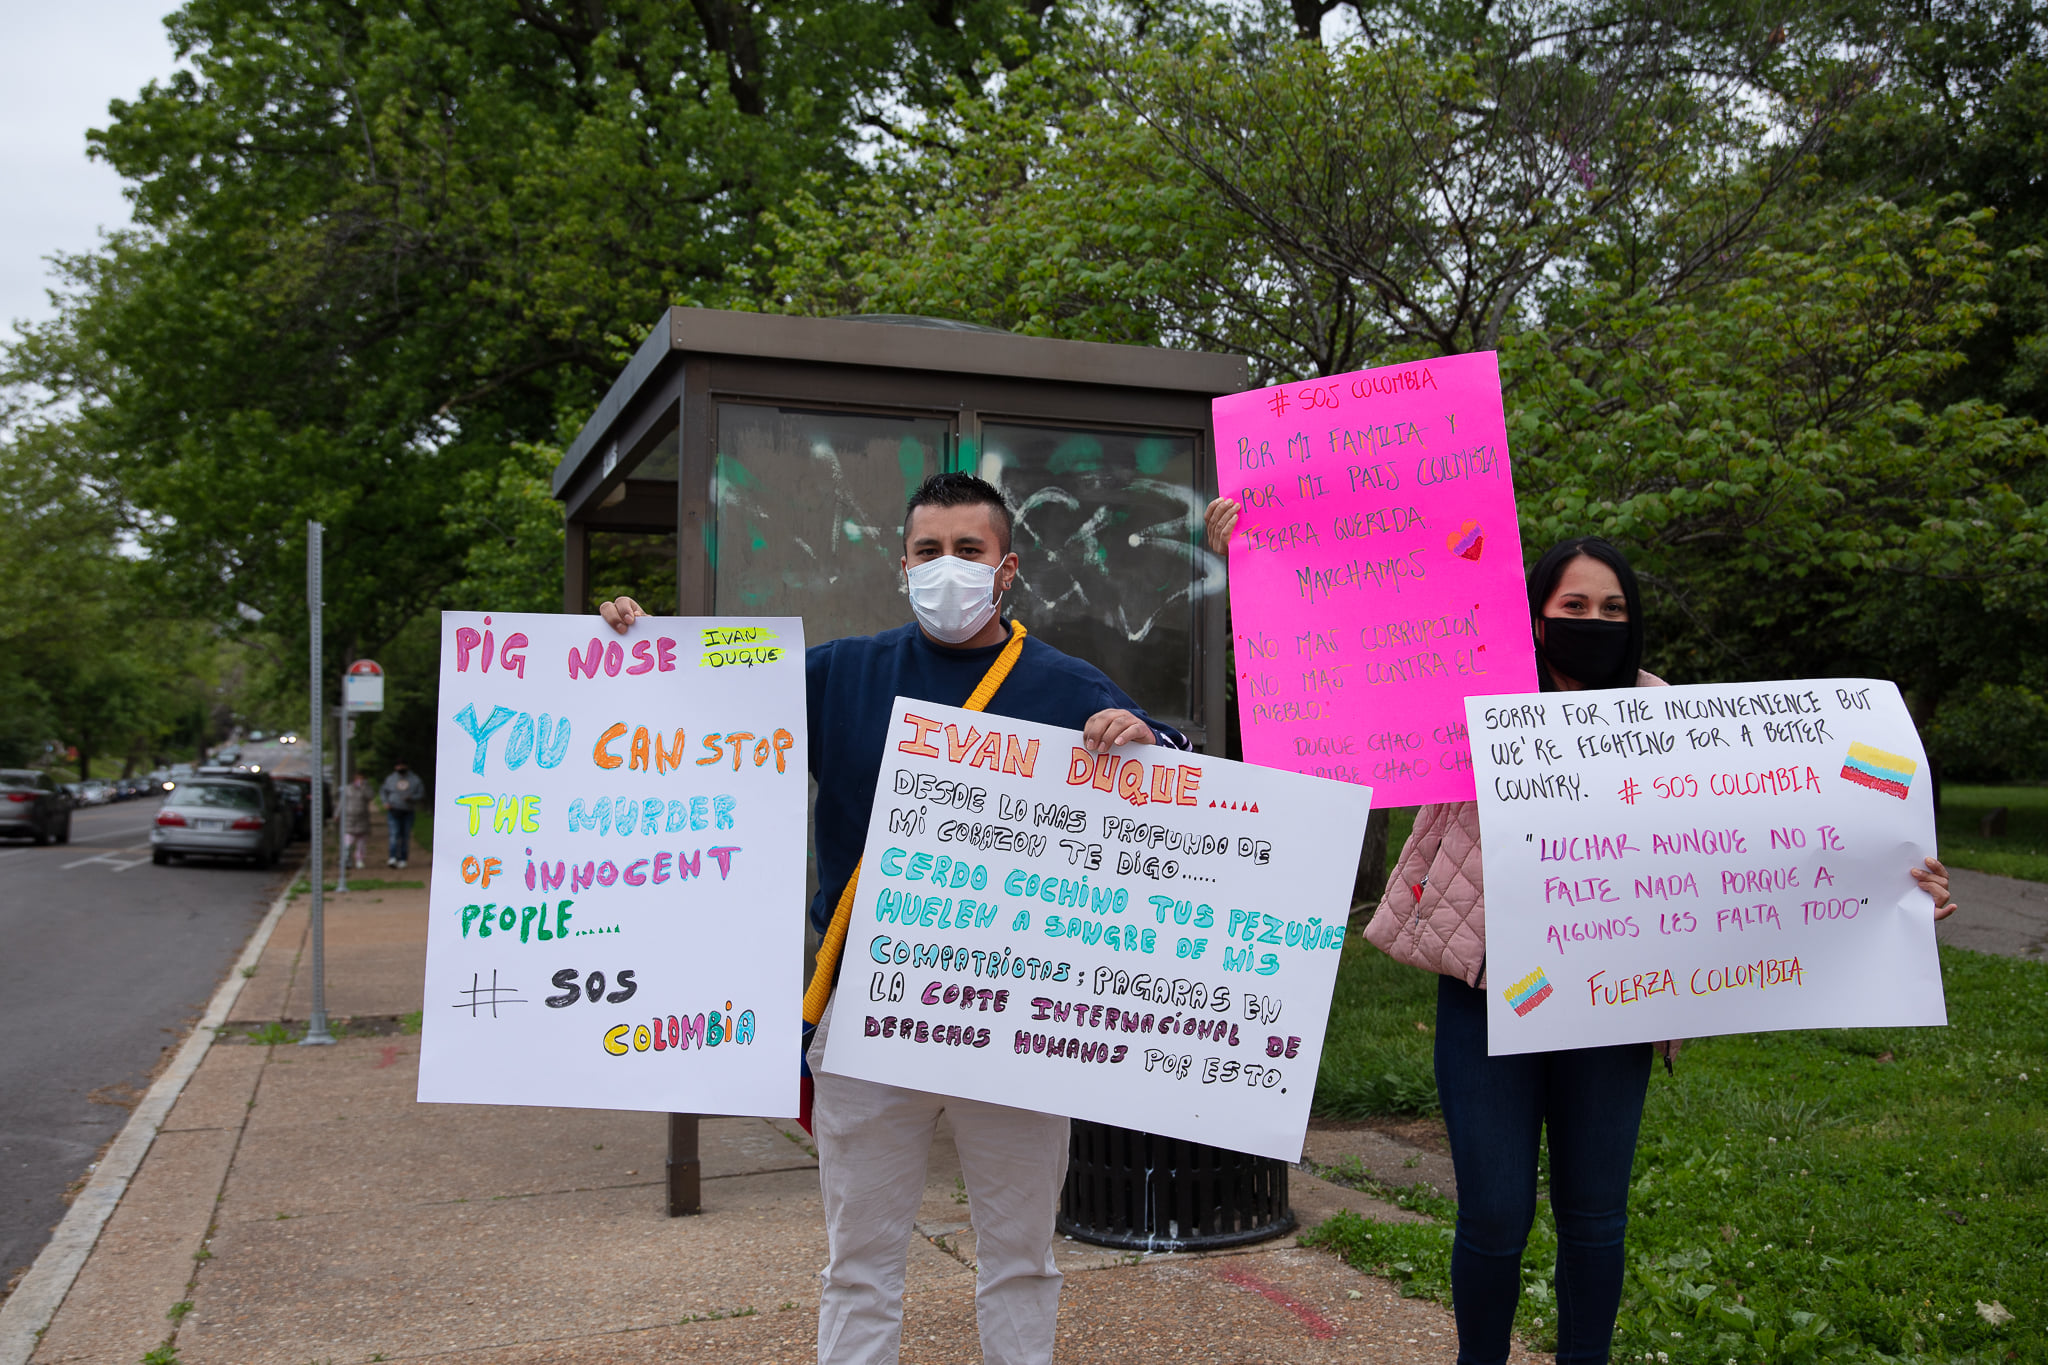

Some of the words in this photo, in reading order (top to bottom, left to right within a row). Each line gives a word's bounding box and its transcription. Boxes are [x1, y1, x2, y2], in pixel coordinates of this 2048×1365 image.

[1298, 384, 1339, 410] SOS
[1352, 368, 1437, 399] COLOMBIA
[1238, 437, 1275, 469] POR
[1288, 432, 1311, 462] MI
[1329, 422, 1429, 456] FAMILIA
[1445, 414, 1458, 434] Y
[1242, 484, 1284, 513] POR
[1298, 474, 1330, 500] MI
[1347, 462, 1400, 492] PAIS
[1240, 522, 1320, 553] TIERRA
[1296, 549, 1425, 604] MARCHAMOS
[568, 636, 677, 680] NOSE
[705, 628, 758, 647] IVAN
[708, 649, 778, 668] DUQUE
[1297, 629, 1340, 661] MAS
[1303, 664, 1352, 694] MAS
[1366, 652, 1449, 686] CONTRA
[1485, 707, 1546, 728] SORRY
[1562, 702, 1609, 726] FOR
[1618, 699, 1653, 723] THE
[1665, 690, 1823, 720] INCONVENIENCE
[1840, 688, 1873, 711] BUT
[452, 702, 571, 776] YOU
[593, 722, 686, 776] CAN
[695, 728, 793, 774] STOP
[898, 713, 1040, 778] IVAN
[1294, 736, 1360, 757] DUQUE
[1368, 732, 1424, 752] CHAO
[1491, 736, 1562, 766] WE'RE
[1578, 730, 1675, 759] FIGHTING
[1686, 727, 1730, 750] FOR
[1741, 725, 1754, 747] A
[1765, 719, 1834, 744] BETTER
[1300, 765, 1364, 784] RIBE
[1373, 759, 1430, 783] CHAO
[1495, 772, 1589, 802] COUNTRY.
[1652, 774, 1698, 799] SOS
[1710, 766, 1821, 797] COLOMBIA
[455, 793, 541, 836] THE
[568, 794, 737, 837] MURDER
[893, 769, 987, 814] DESDE
[998, 794, 1028, 820] LO
[1034, 801, 1086, 833] MAS
[1103, 816, 1229, 856] PROFUNDO
[1238, 837, 1272, 865] DE
[937, 820, 1047, 858] CORAZON
[1060, 840, 1102, 870] TE
[1652, 828, 1748, 855] AUNQUE
[1770, 828, 1806, 851] NO
[1817, 825, 1845, 851] TE
[461, 856, 503, 889] OF
[880, 848, 988, 891] CERDO
[1148, 895, 1214, 928] TUS
[1543, 877, 1620, 906] FALTE
[1634, 872, 1699, 900] NADA
[1721, 868, 1800, 894] PORQUE
[1813, 866, 1834, 889] A
[876, 888, 998, 930] HUELEN
[1012, 910, 1031, 931] A
[1044, 915, 1157, 953] SANGRE
[1176, 937, 1207, 958] DE
[1546, 916, 1640, 954] ALGUNOS
[1659, 911, 1697, 933] LES
[1717, 903, 1782, 933] FALTA
[545, 968, 637, 1009] SOS
[1093, 966, 1230, 1011] PAGARAS
[1243, 994, 1282, 1024] EN
[1587, 970, 1678, 1008] FUERZA
[1690, 957, 1803, 995] COLOMBIA
[870, 972, 905, 1003] LA
[921, 982, 1009, 1012] CORTE
[1265, 1035, 1302, 1059] DE
[864, 1015, 991, 1048] DERECHOS
[1014, 1030, 1128, 1064] HUMANOS
[1144, 1048, 1192, 1079] POR
